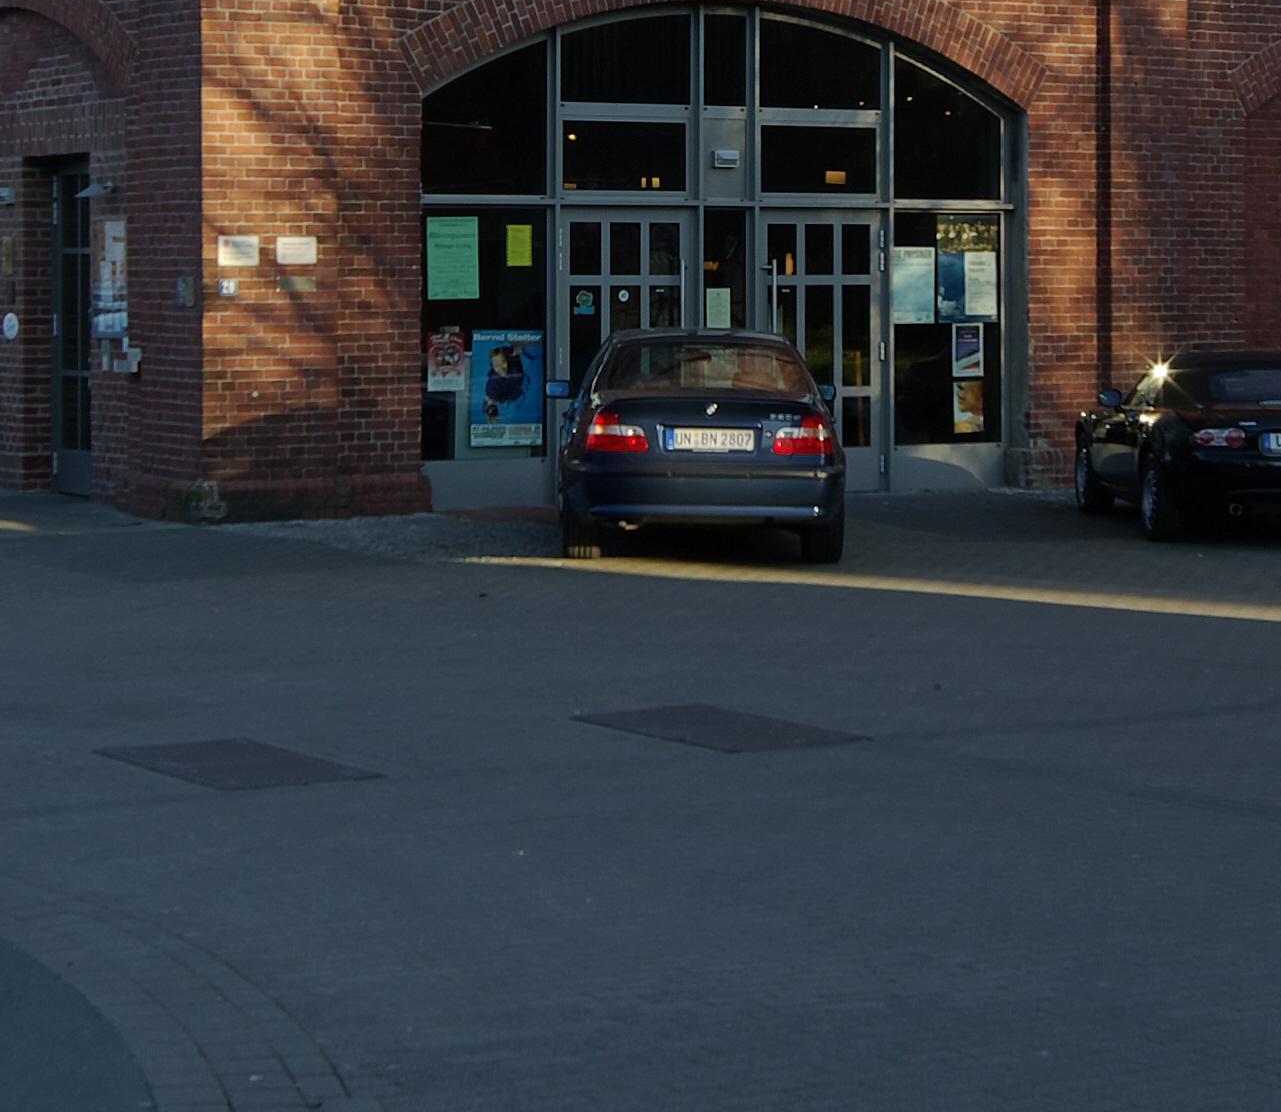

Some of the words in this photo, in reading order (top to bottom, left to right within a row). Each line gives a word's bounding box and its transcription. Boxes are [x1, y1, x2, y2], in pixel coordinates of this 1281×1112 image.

[675, 432, 692, 447] UN
[701, 432, 718, 446] BN
[721, 432, 752, 447] 2807
